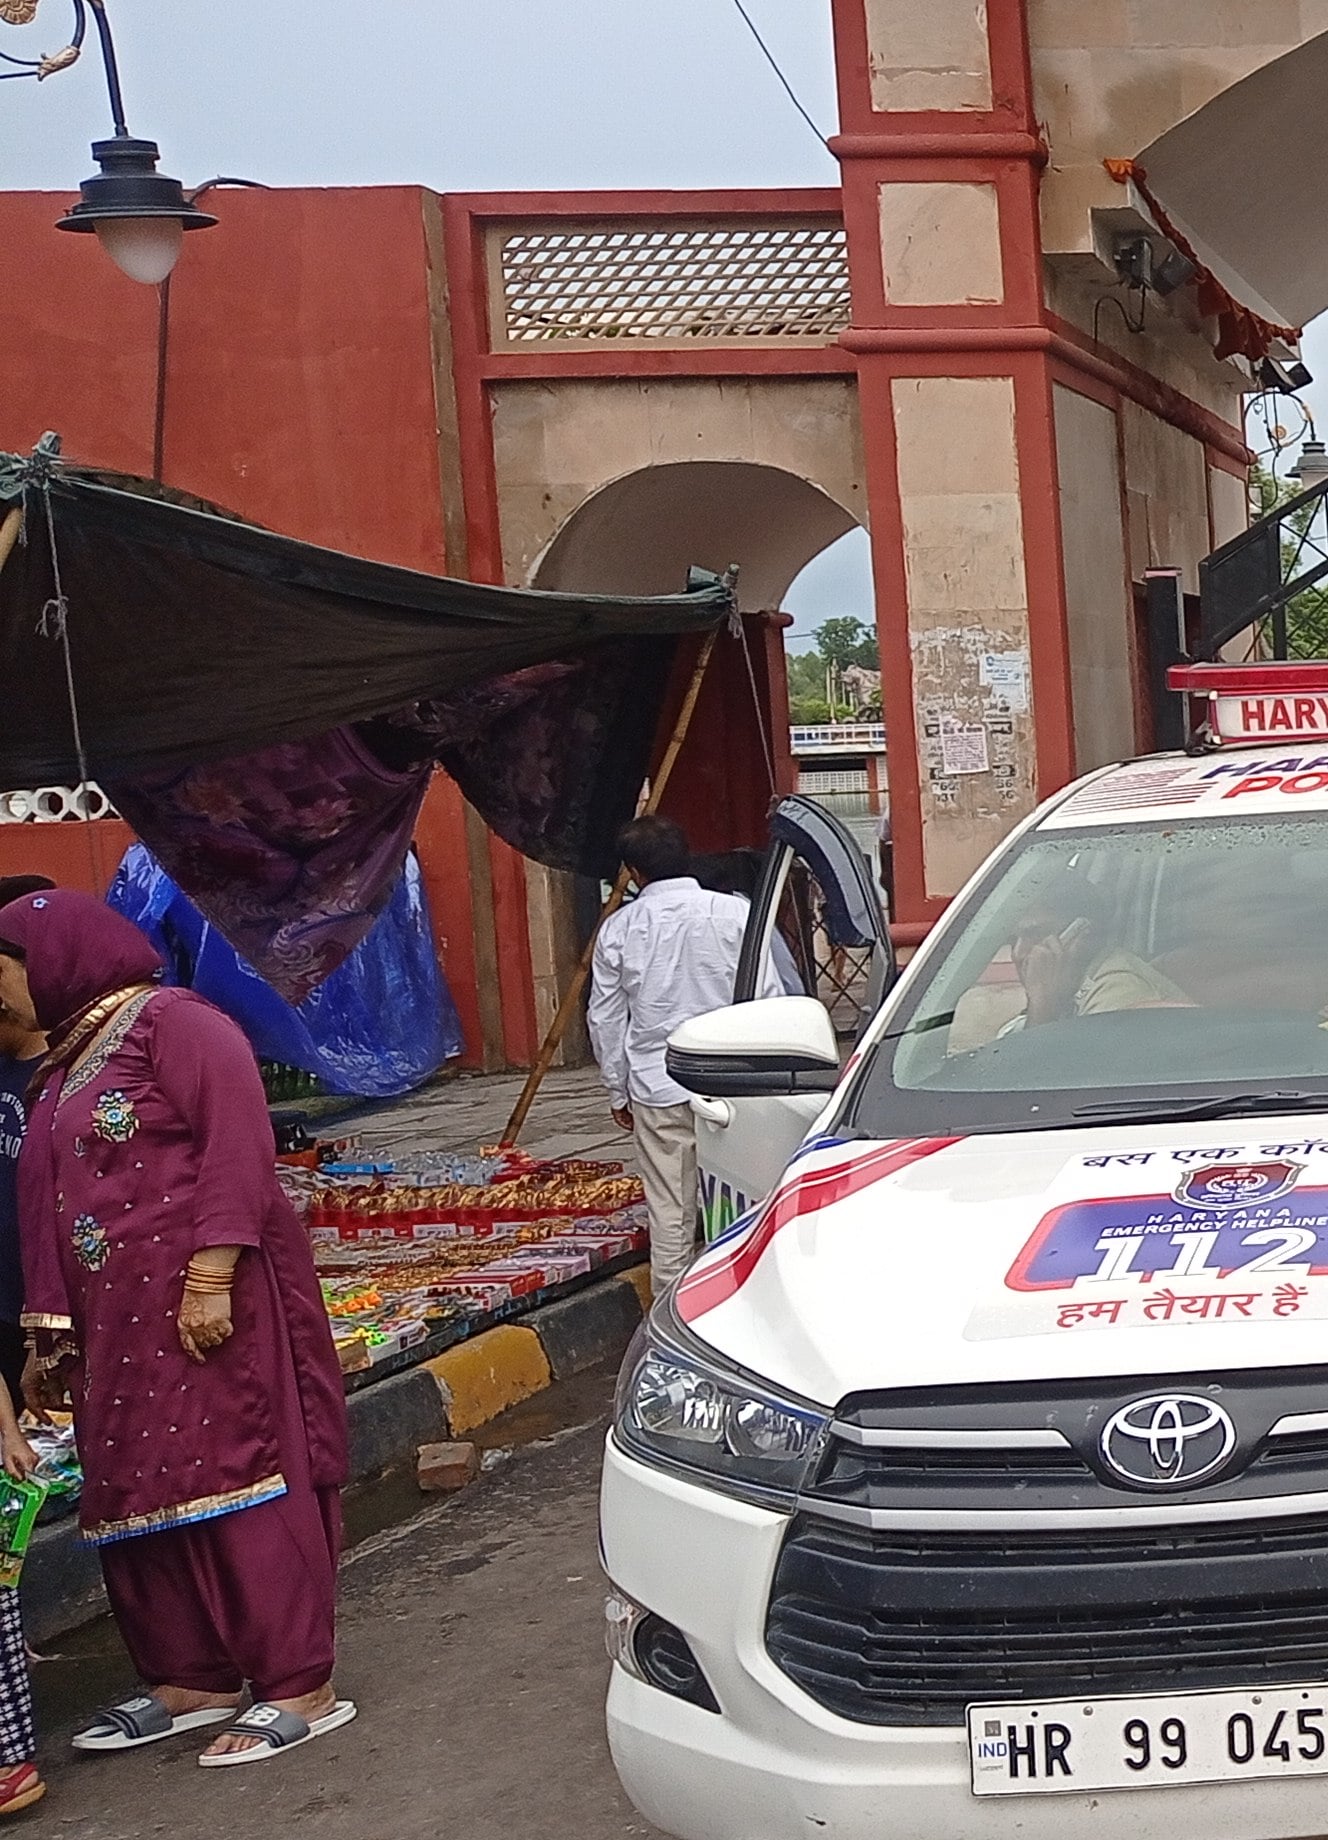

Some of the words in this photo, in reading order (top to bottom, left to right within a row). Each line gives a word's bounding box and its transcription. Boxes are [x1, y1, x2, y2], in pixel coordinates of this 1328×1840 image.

[1083, 1152, 1157, 1168] बस
[1171, 1146, 1246, 1164] एक
[1100, 1220, 1228, 1238] EMERGENCY
[1147, 1207, 1292, 1224] HARYANA
[1074, 1227, 1318, 1284] 112
[1056, 1299, 1129, 1328] हम
[1142, 1288, 1263, 1321] तैयार
[1271, 1282, 1309, 1317] हैं
[978, 1742, 1007, 1758] IND
[1006, 1723, 1074, 1779] HR
[1123, 1717, 1189, 1771] 99
